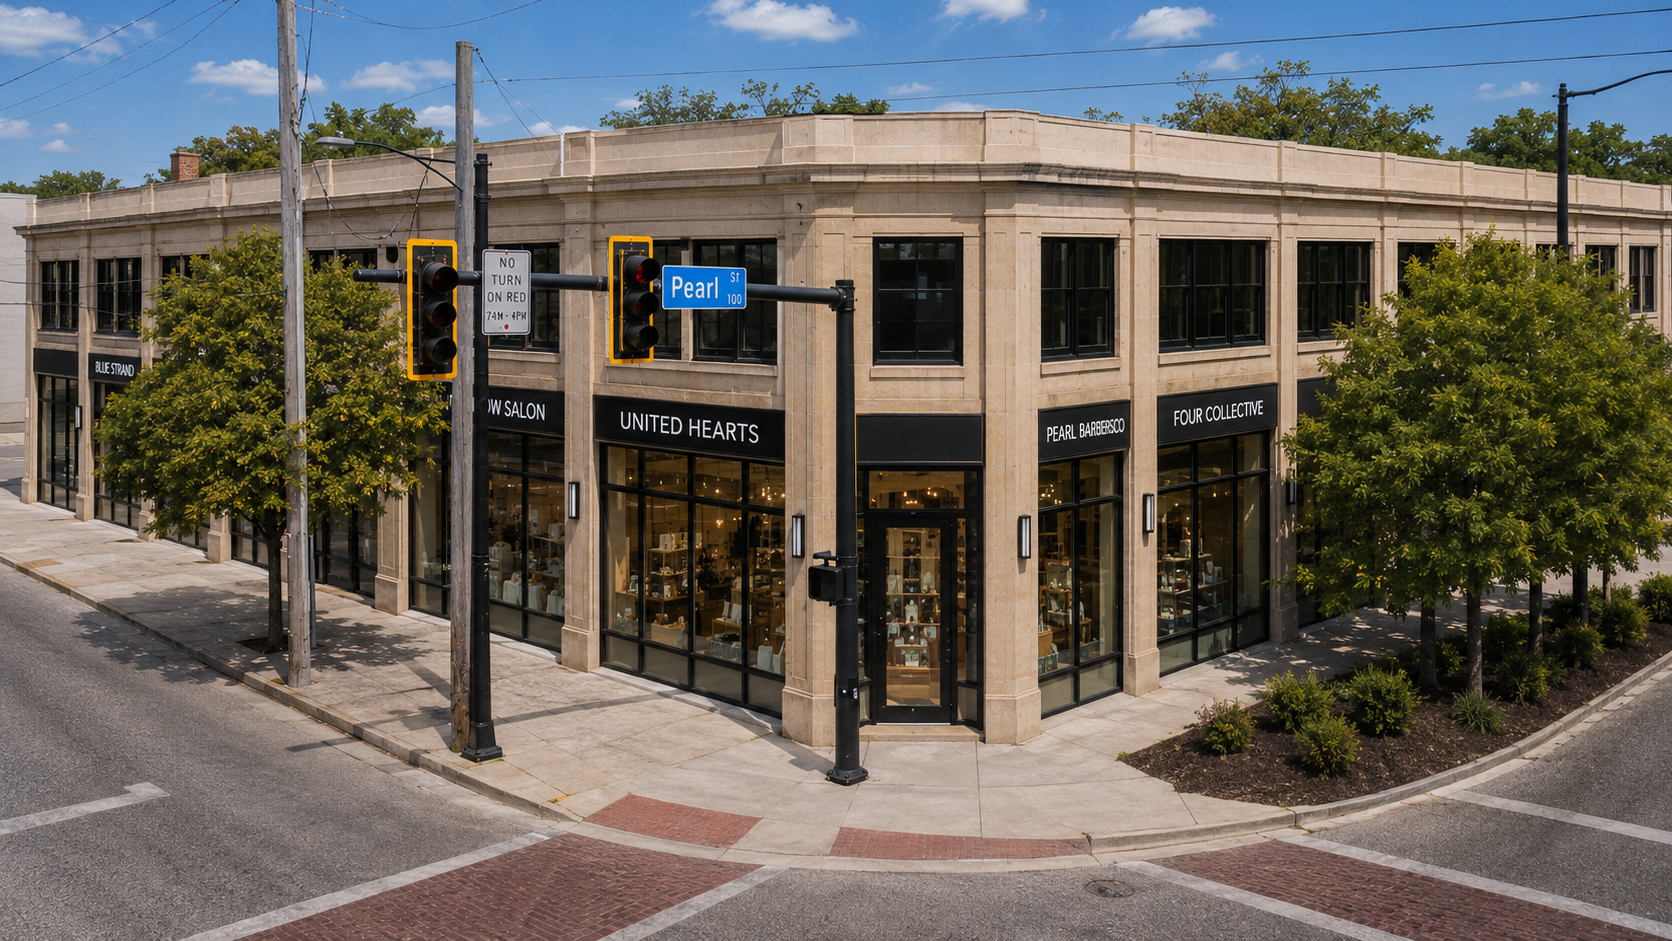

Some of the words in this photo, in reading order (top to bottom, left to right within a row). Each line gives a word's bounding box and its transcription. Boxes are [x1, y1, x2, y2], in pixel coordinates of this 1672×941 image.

[500, 257, 515, 269] NO
[491, 274, 522, 286] TURN
[672, 276, 719, 299] Pearl
[487, 291, 502, 303] ON
[507, 291, 526, 303] RED
[727, 294, 742, 305] 100
[486, 311, 504, 321] 7AM
[95, 361, 110, 374] BLUE
[111, 363, 135, 377] STRAND
[504, 400, 546, 421] SALON
[1173, 407, 1203, 427] FOUR
[1205, 400, 1264, 423] COLLECTIVE
[620, 411, 683, 435] UNITED
[689, 419, 760, 444] HEARTS
[1046, 424, 1077, 443] PEARL
